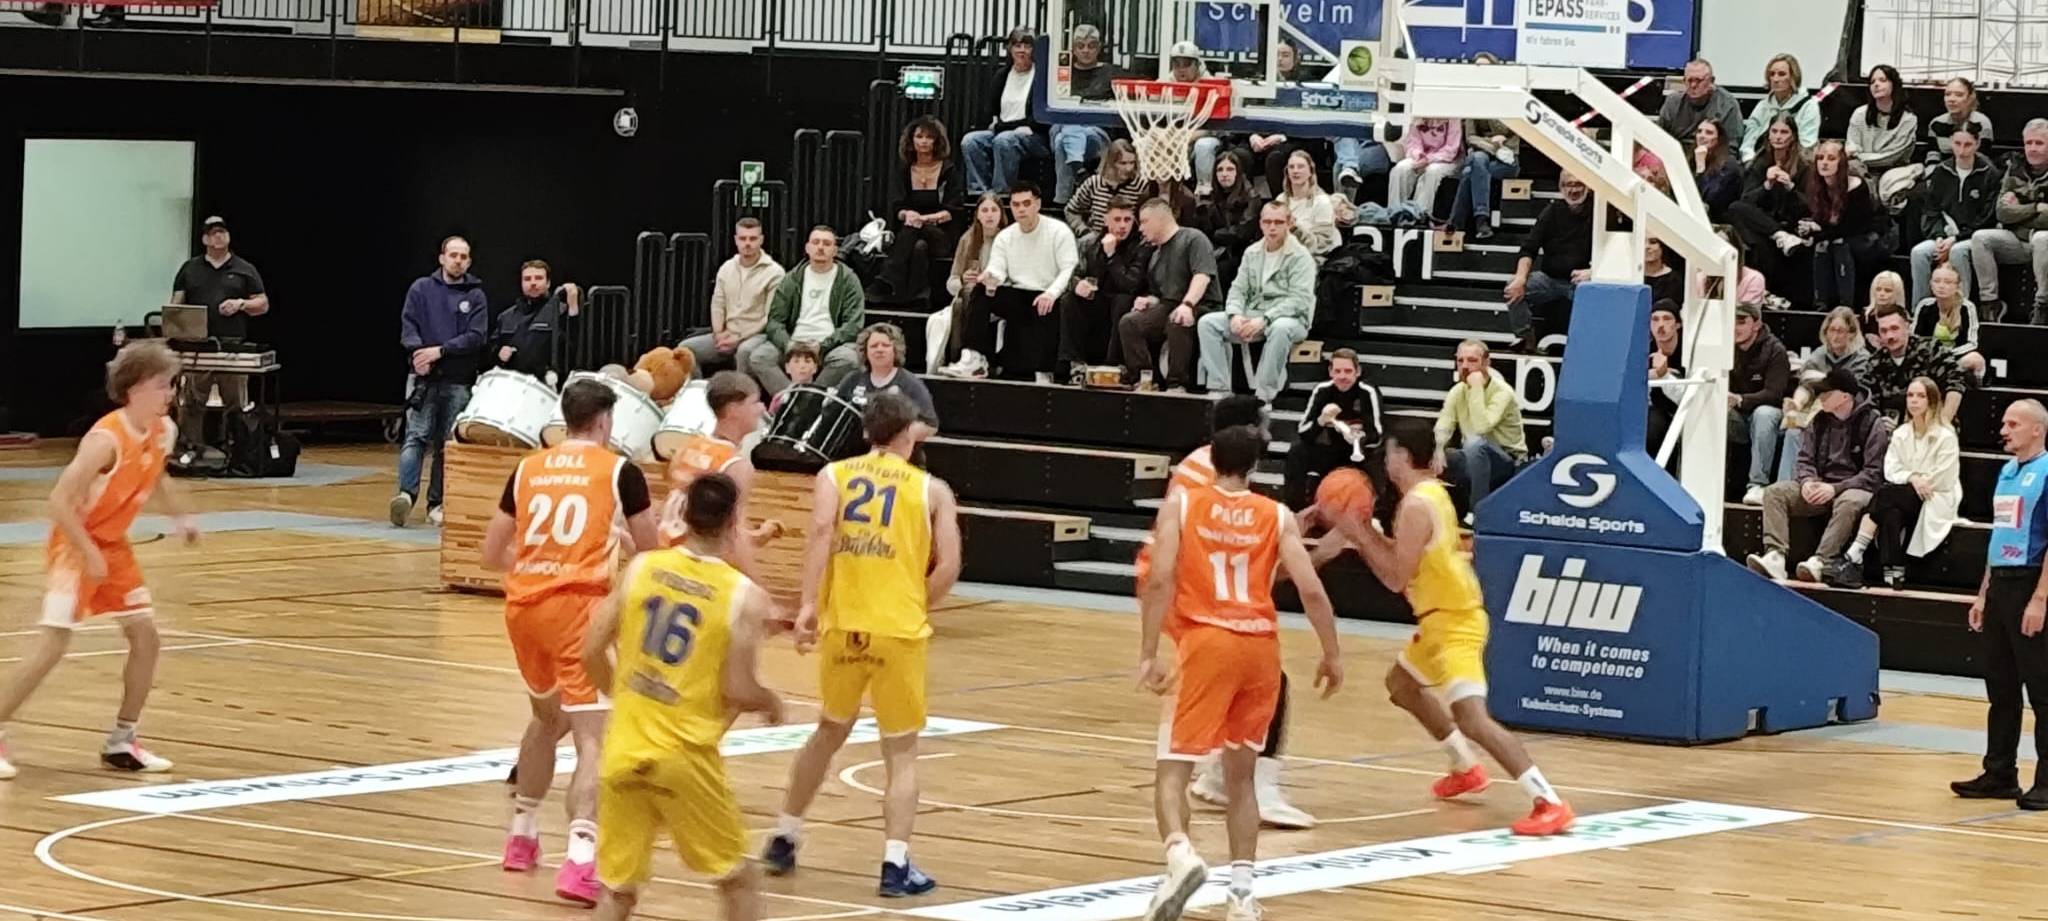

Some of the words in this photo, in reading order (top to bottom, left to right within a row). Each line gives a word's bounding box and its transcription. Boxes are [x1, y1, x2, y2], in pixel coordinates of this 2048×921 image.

[1527, 0, 1584, 18] TEPASS
[544, 454, 588, 470] LOLL
[843, 476, 898, 528] 21
[1210, 502, 1257, 528] PAGE
[524, 493, 589, 546] 20
[1519, 510, 1588, 529] Schelde
[1588, 516, 1646, 534] Sports
[1208, 551, 1251, 604] 11
[1504, 553, 1644, 634] biw
[642, 596, 702, 666] 16
[1537, 635, 1581, 656] When
[1584, 640, 1598, 657] it
[1600, 645, 1651, 663] comes
[1531, 654, 1548, 669] to
[1550, 658, 1645, 679] competence
[1521, 697, 1625, 718] Kabelschutz-Systeme
